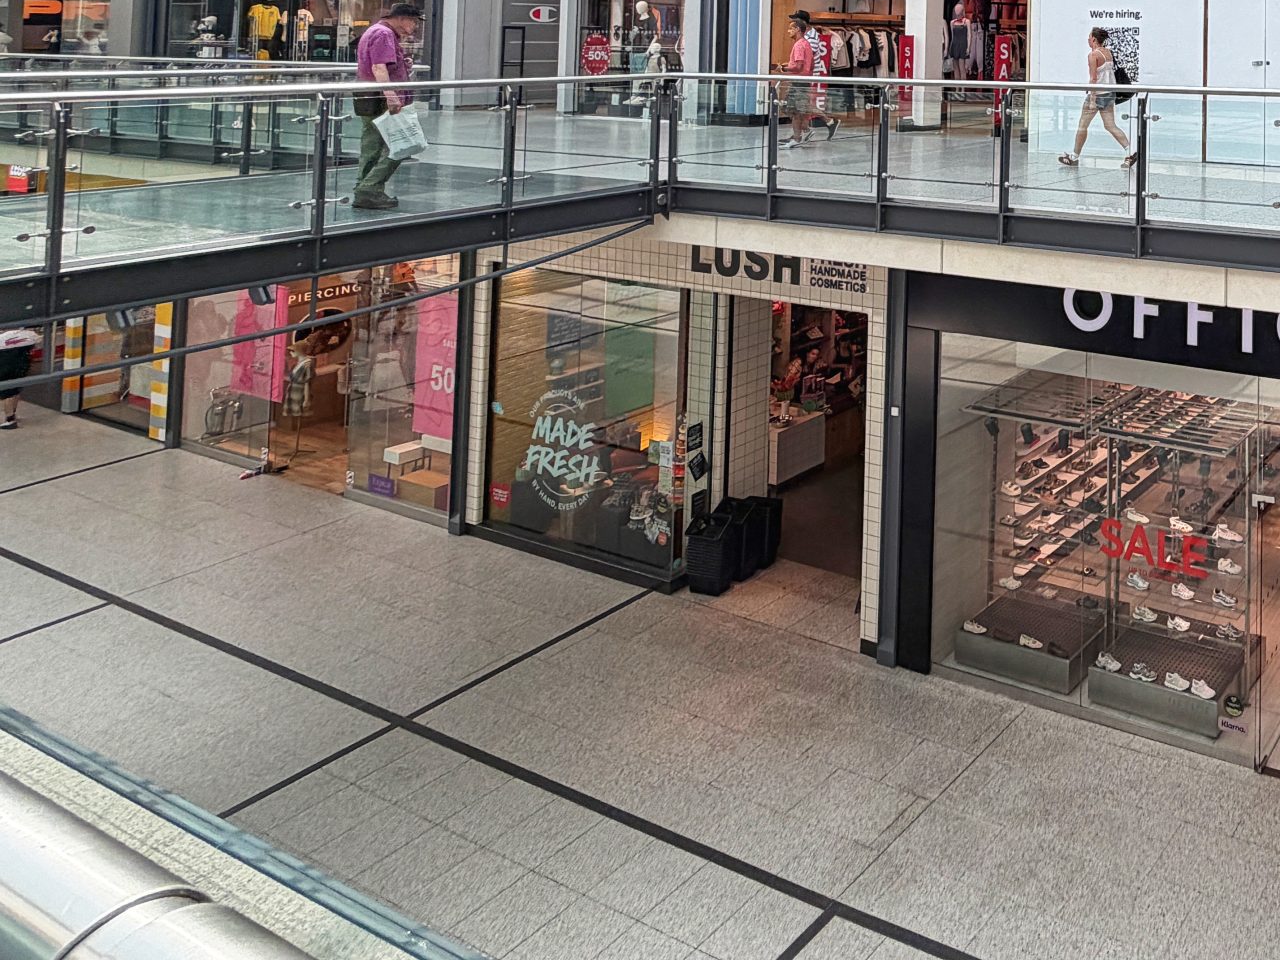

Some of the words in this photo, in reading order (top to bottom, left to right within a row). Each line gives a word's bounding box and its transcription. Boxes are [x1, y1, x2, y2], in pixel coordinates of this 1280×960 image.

[1090, 10, 1114, 19] We're
[1115, 9, 1143, 21] hiring.
[816, 41, 828, 111] SALE
[691, 244, 801, 286] LUSH
[809, 265, 867, 282] HANDMADE
[288, 284, 362, 305] PIERCING
[809, 278, 867, 294] COSMETICS
[531, 415, 598, 451] MADE
[525, 444, 601, 486] FRESH
[558, 500, 578, 511] EVERY
[1100, 517, 1210, 578] SALE
[1221, 720, 1246, 734] Klarna.
